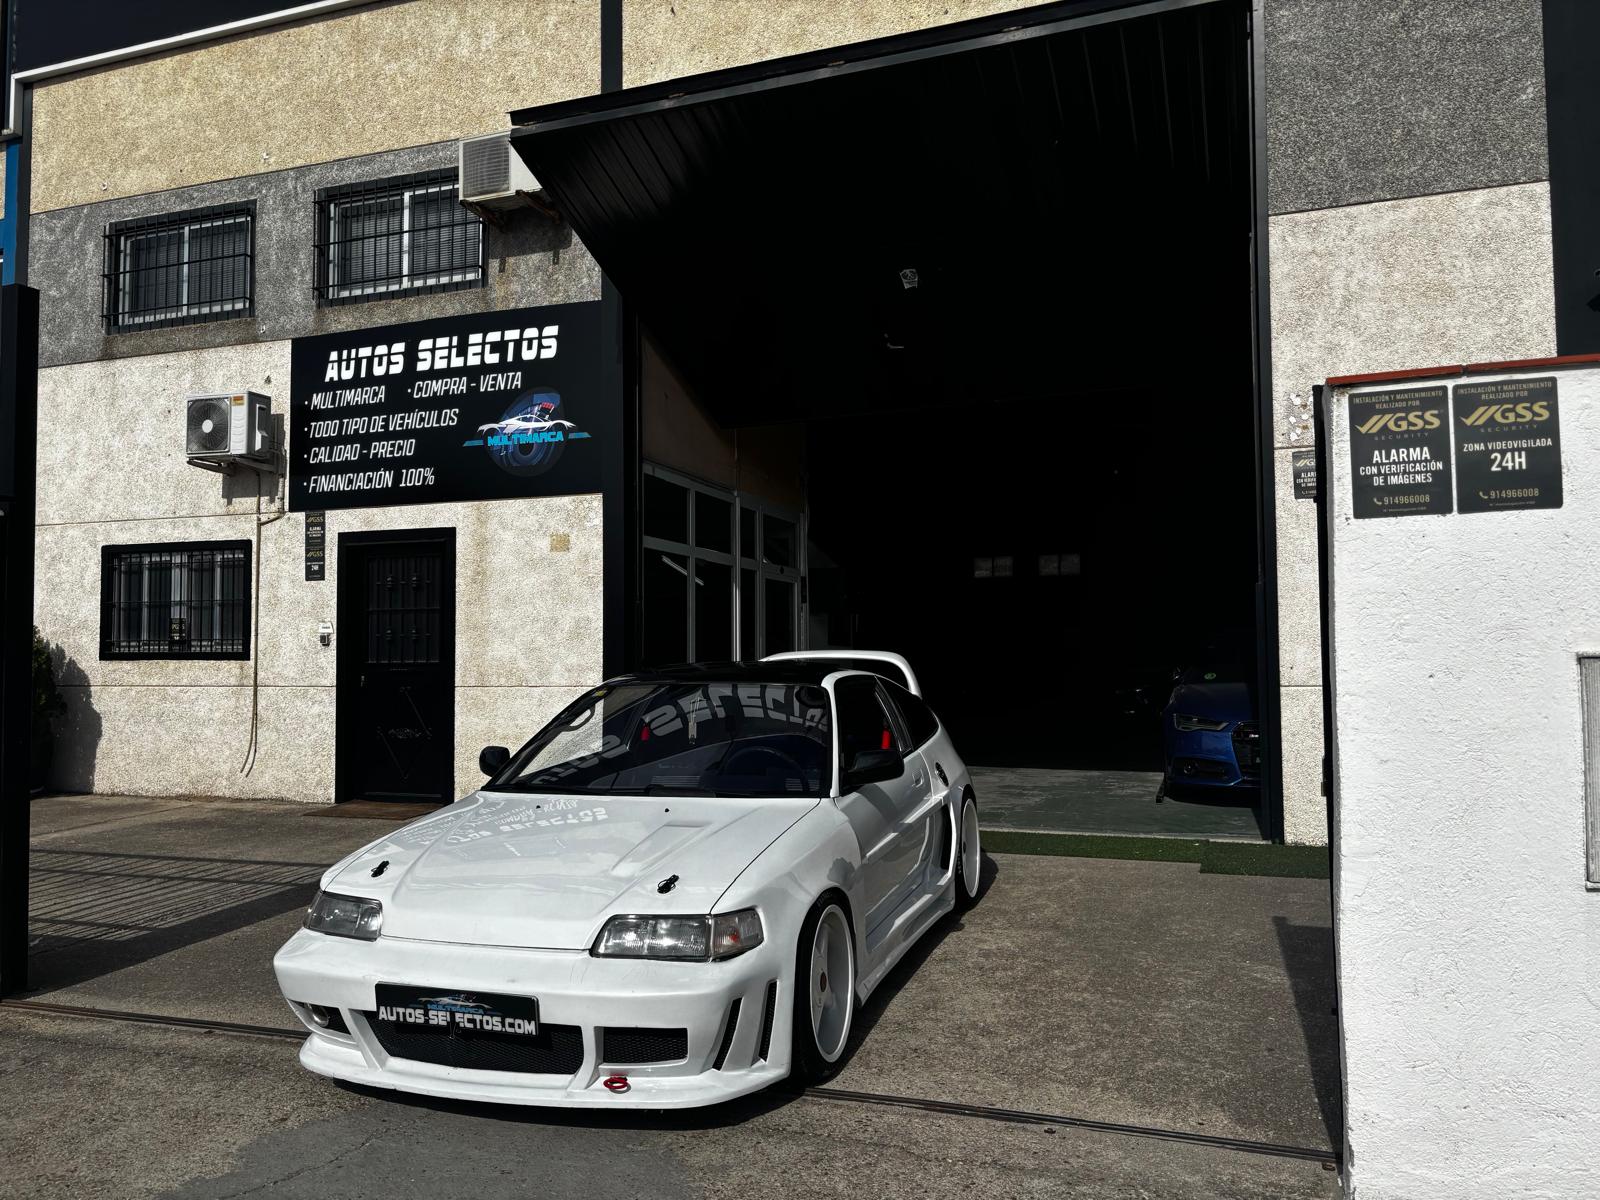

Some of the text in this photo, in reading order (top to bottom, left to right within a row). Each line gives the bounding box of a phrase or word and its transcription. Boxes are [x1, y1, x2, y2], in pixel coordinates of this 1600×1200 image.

[325, 325, 559, 382] AUTOS SELECTOS
[413, 376, 467, 398] COMPRA
[480, 372, 522, 392] VENTA
[311, 385, 385, 410] MULTIMARCA
[1375, 399, 1420, 409] REALIZADO POR
[1396, 391, 1442, 400] MANTENIMIENTO
[1481, 392, 1514, 400] REALIZADO
[1387, 409, 1441, 432] GSS
[1494, 401, 1550, 424] GSS
[309, 408, 459, 438] TODO TIPO DE VEHÍCULOS
[487, 431, 565, 447] MULTIMARCA
[1463, 438, 1552, 452] ZONA VIDEOVIGILADA
[309, 443, 360, 464] CALIDAD
[369, 439, 416, 459] PRECIO
[1372, 446, 1431, 464] ALARMA
[1359, 460, 1443, 475] CON VERIFICACIÓN
[1490, 451, 1526, 471] 24H
[309, 467, 435, 493] FINANCIACIÓN 100%
[1373, 472, 1432, 486] DE IMÁGENES
[1383, 494, 1430, 505] 914966008
[1489, 488, 1540, 499] 914966008
